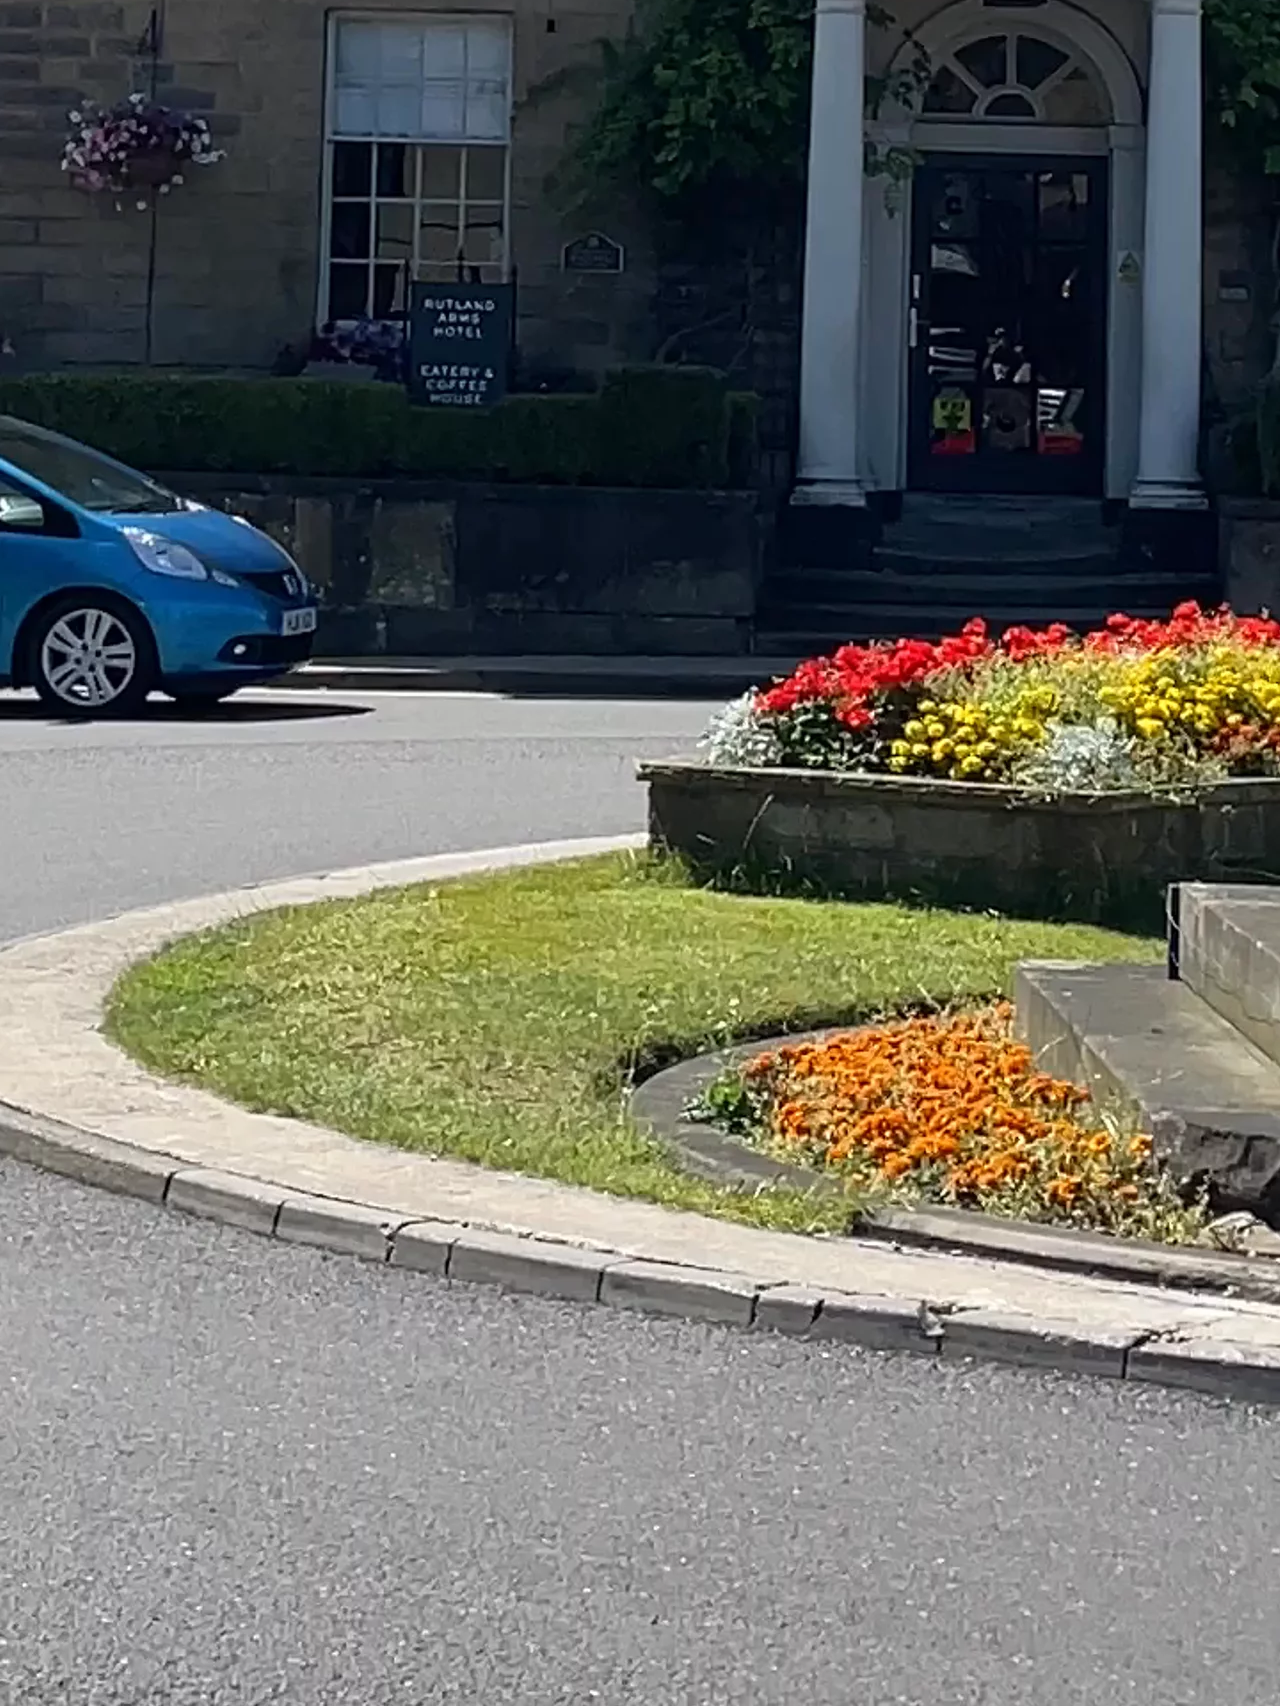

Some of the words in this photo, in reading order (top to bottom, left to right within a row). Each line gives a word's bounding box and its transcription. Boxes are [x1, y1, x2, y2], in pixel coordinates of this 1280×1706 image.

[424, 298, 495, 311] RUTLAND
[438, 312, 481, 325] ARMS
[433, 326, 482, 339] HOTEL
[420, 365, 480, 377] EATERY
[425, 379, 488, 391] COFFEE
[429, 393, 482, 405] HOUSE
